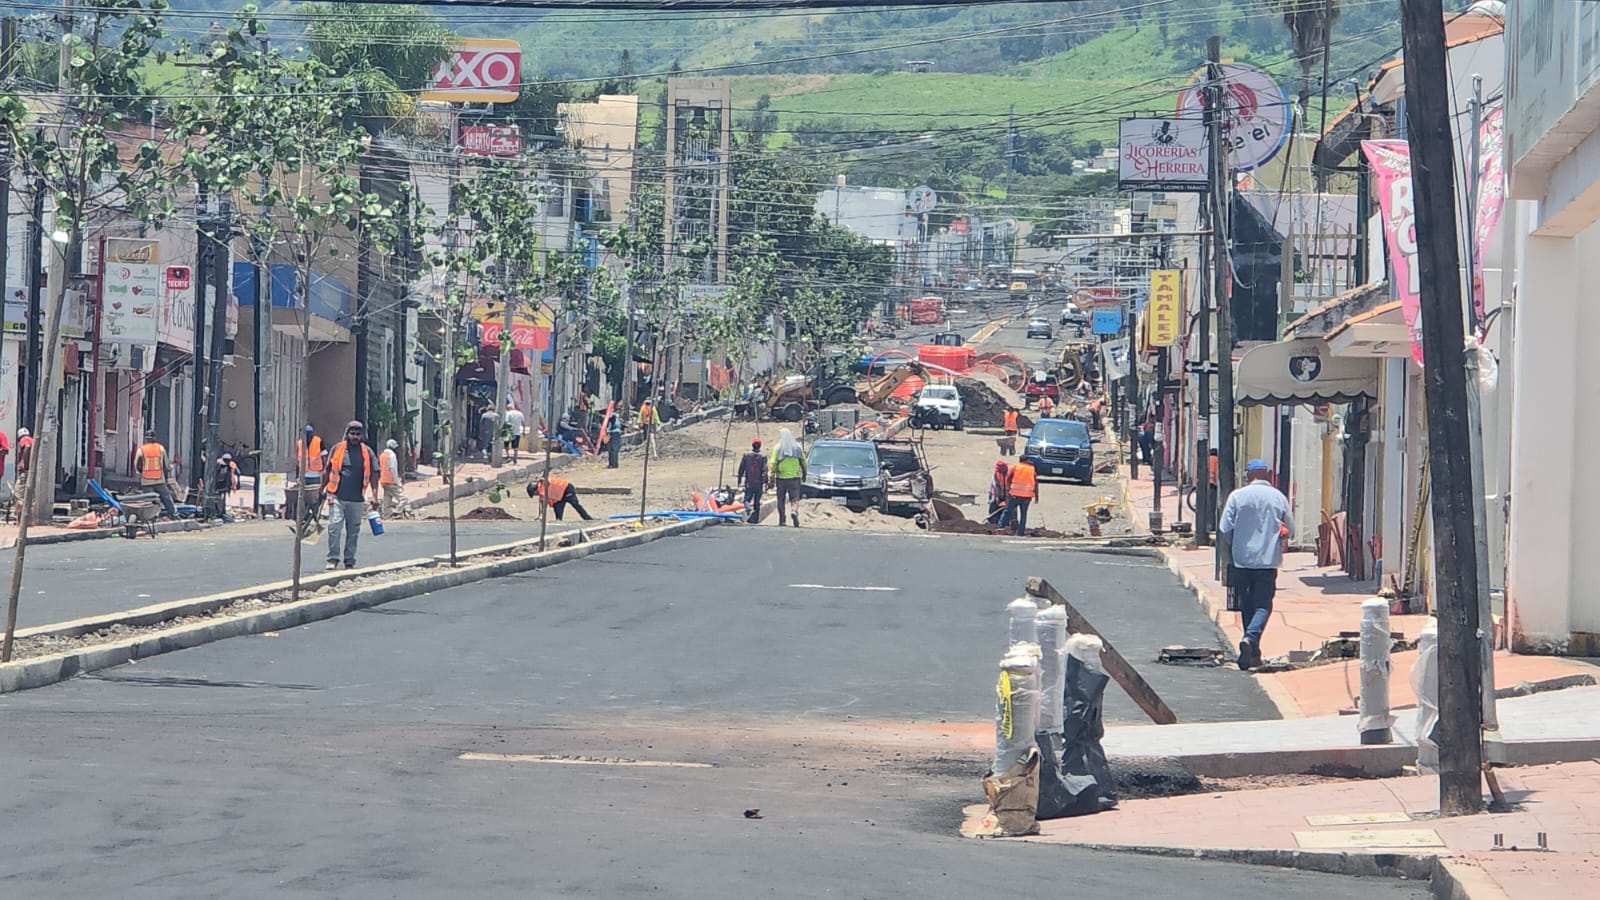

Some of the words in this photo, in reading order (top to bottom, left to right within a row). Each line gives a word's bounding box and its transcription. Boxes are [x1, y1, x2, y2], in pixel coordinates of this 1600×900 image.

[463, 132, 491, 151] ABIERTO
[1125, 142, 1197, 162] LICORERIAS
[1135, 160, 1205, 181] HERRERA
[1157, 274, 1174, 342] TAMALES
